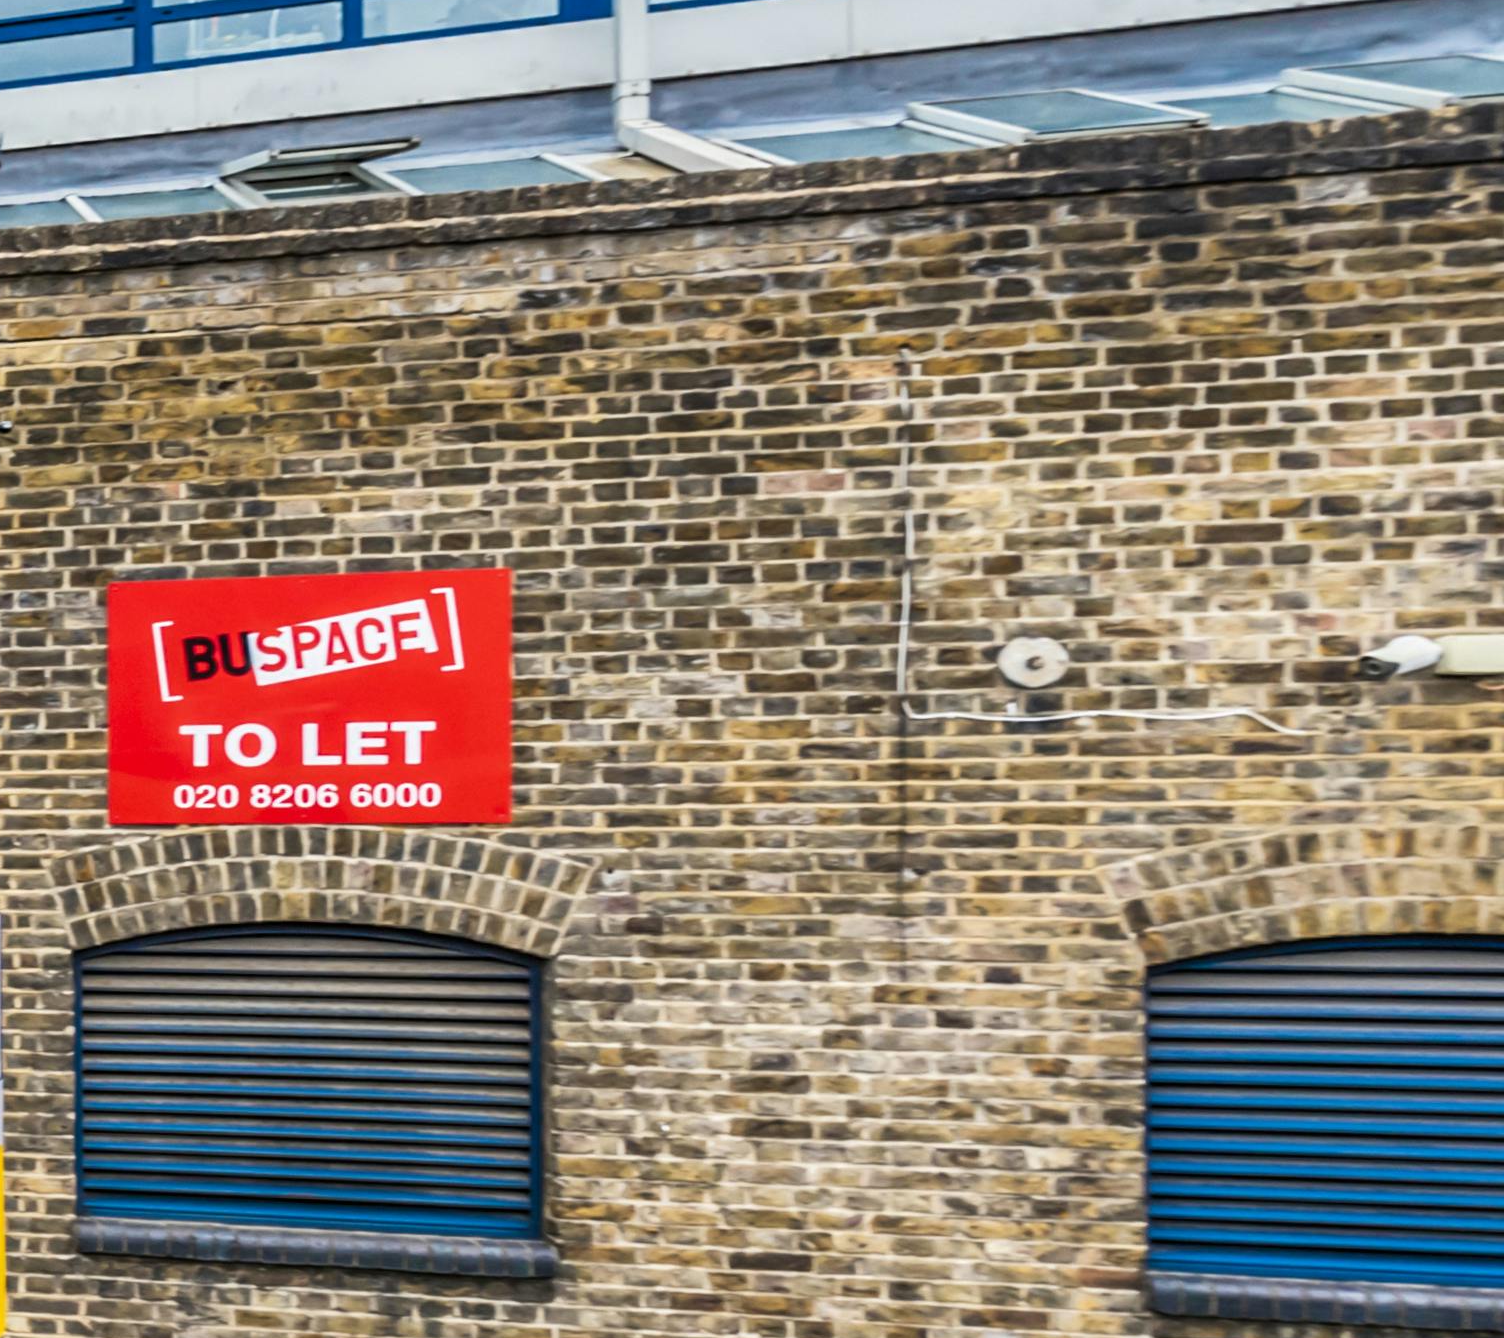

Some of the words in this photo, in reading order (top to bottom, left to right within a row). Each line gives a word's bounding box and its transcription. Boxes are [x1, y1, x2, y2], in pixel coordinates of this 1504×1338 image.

[178, 722, 277, 767] TO
[302, 721, 437, 766] LET
[173, 784, 239, 809] 020
[249, 783, 339, 809] 8206
[350, 783, 442, 808] 6000
